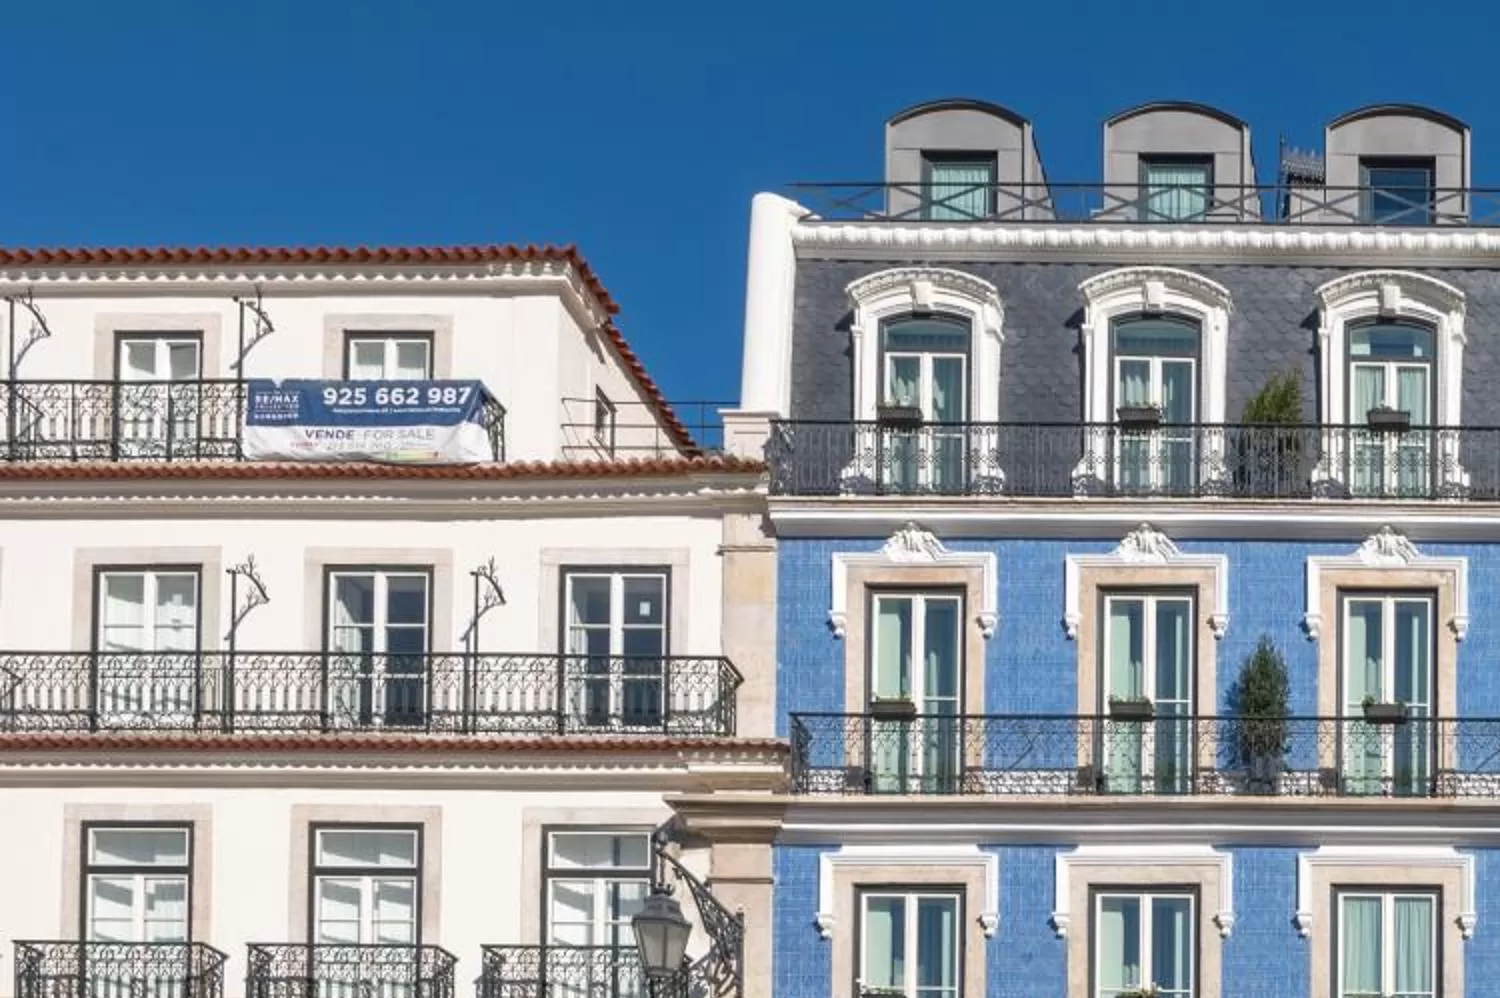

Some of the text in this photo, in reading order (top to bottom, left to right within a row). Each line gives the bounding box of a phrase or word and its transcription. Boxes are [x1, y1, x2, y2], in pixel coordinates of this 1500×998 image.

[323, 386, 472, 405] 925 662 987
[305, 427, 434, 440] VENDE FOR SALE
